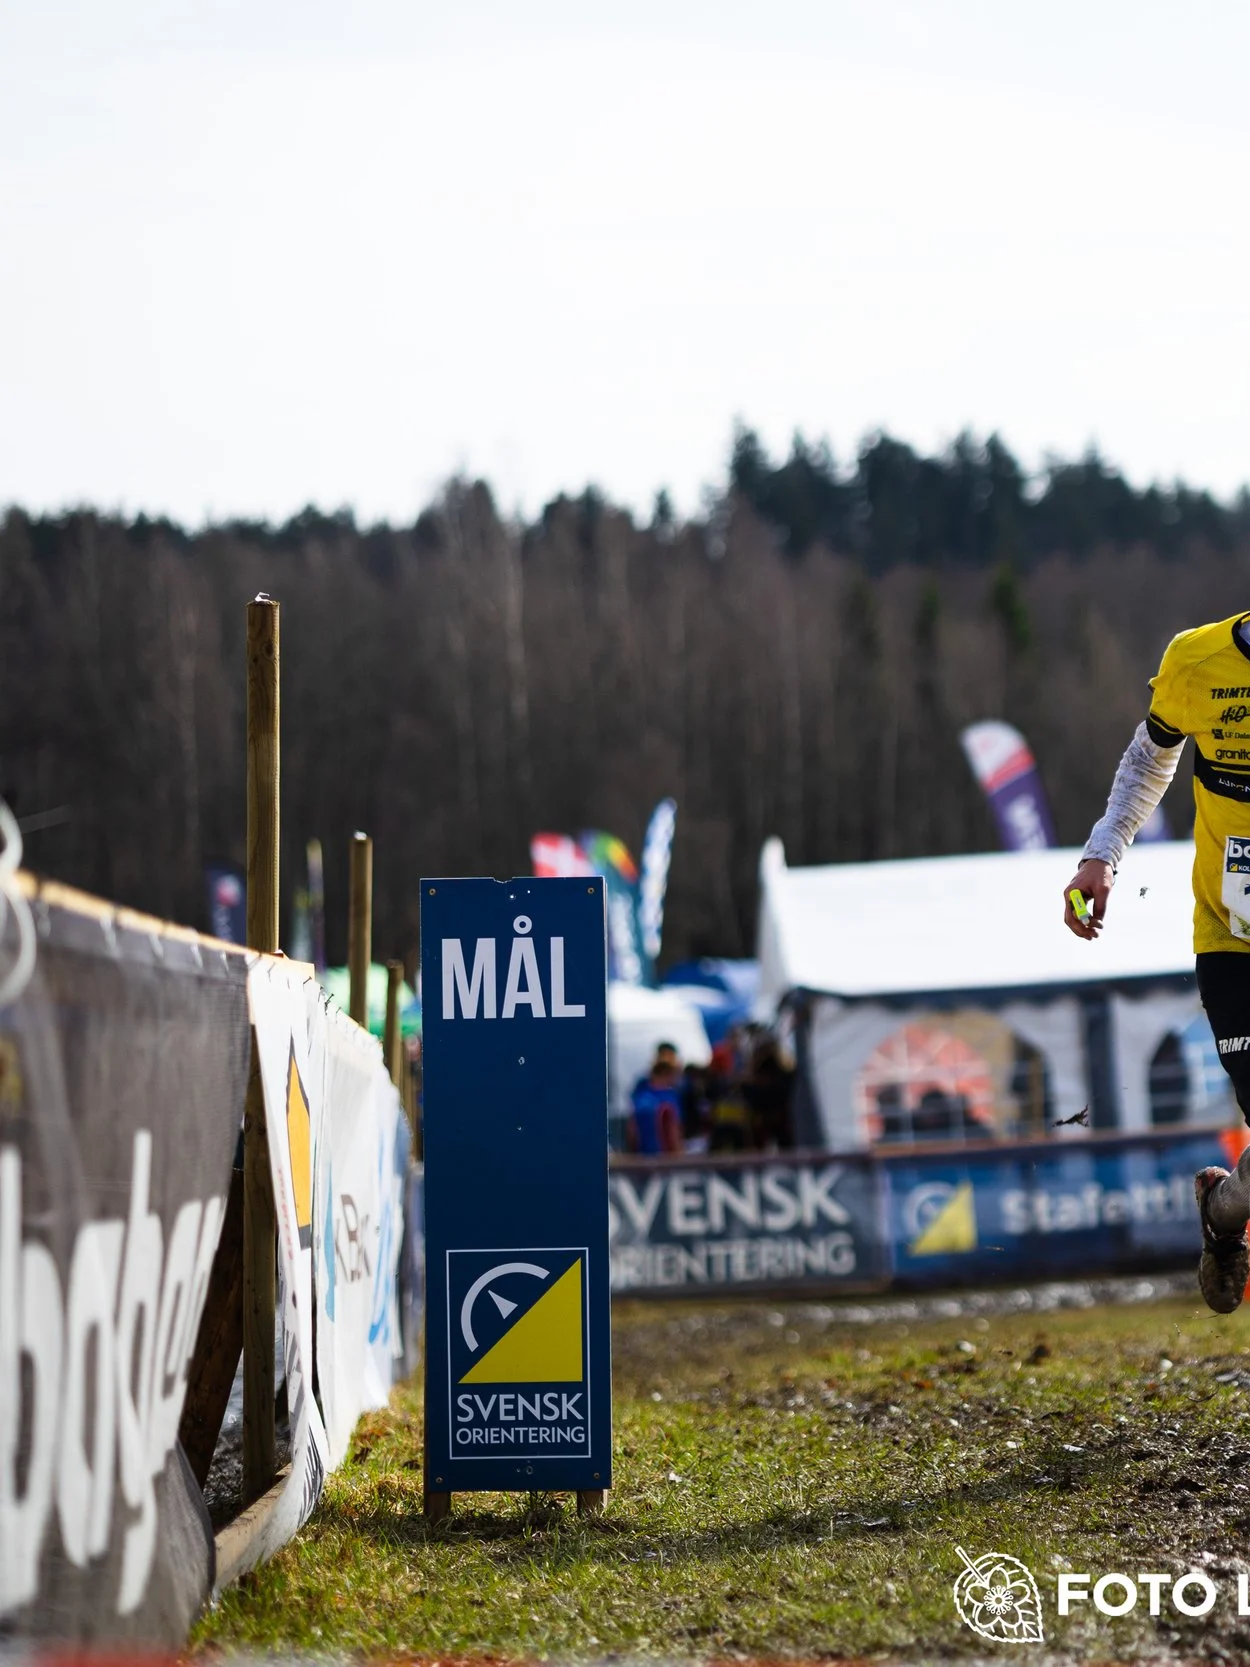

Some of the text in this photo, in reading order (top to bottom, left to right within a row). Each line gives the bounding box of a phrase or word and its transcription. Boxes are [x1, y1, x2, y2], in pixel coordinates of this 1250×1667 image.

[442, 915, 586, 1020] MÅL
[609, 1164, 850, 1236] VENSK
[456, 1392, 584, 1423] SVENSK
[456, 1425, 586, 1445] ORIENTERING
